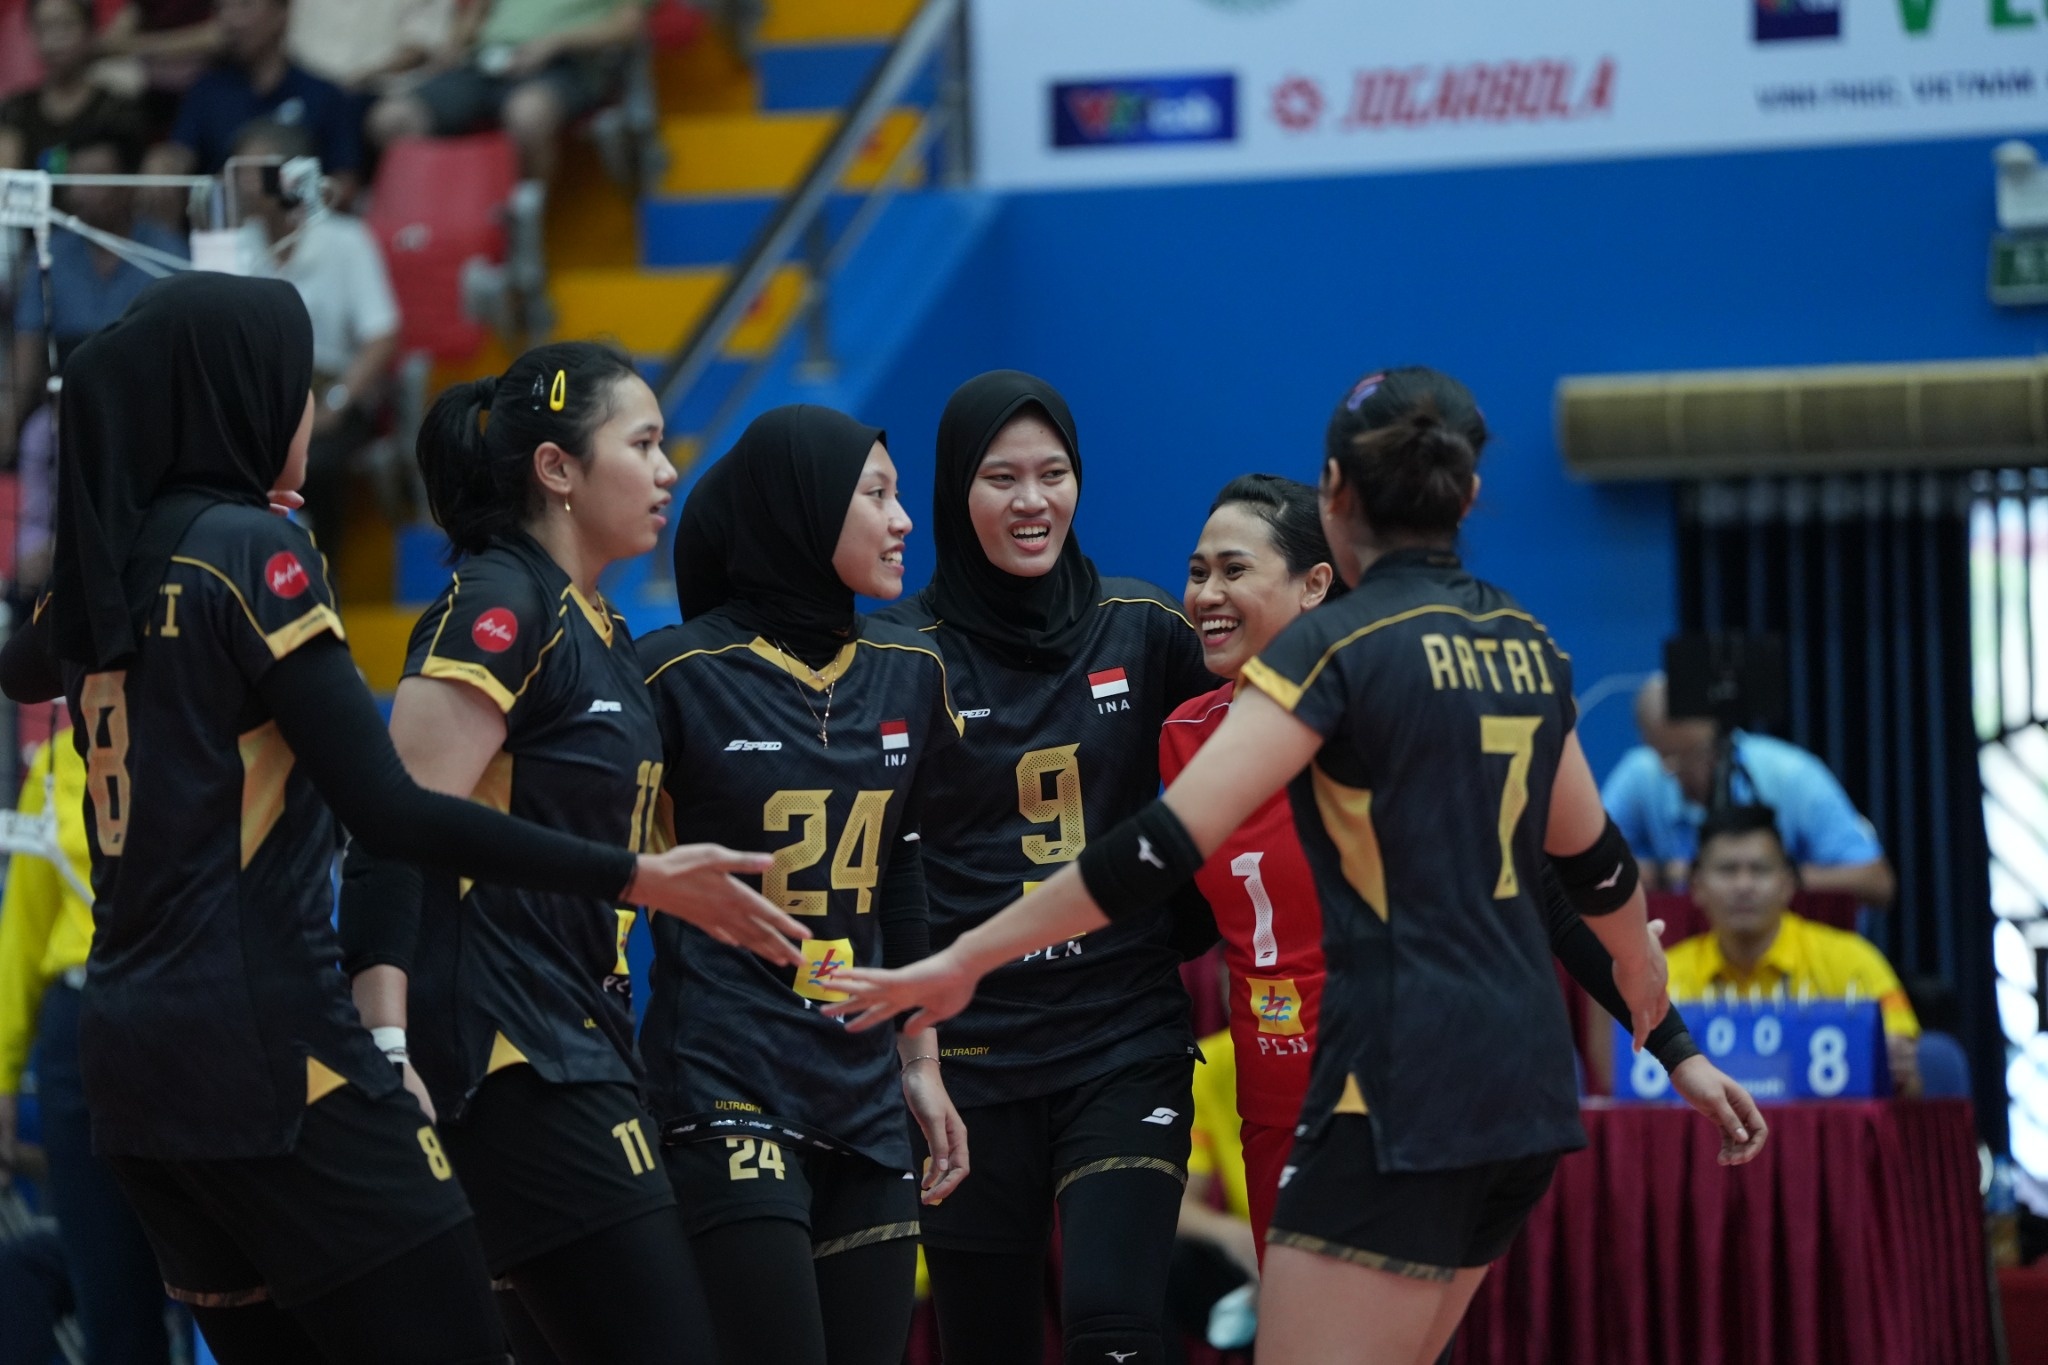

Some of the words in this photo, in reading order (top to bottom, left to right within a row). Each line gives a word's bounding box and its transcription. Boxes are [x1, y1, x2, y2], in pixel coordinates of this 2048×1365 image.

[1421, 633, 1554, 694] RATRI
[1098, 699, 1131, 715] INA
[80, 669, 131, 856] 8
[1016, 742, 1087, 865] 9
[1479, 715, 1544, 900] 7
[762, 789, 895, 917] 24
[1230, 852, 1278, 968] 1
[940, 1046, 990, 1057] ULTRADRY
[1257, 1036, 1308, 1055] PLN
[1706, 1016, 1736, 1057] 0
[1753, 1014, 1783, 1057] 0
[1808, 1026, 1850, 1098] 8
[715, 1100, 763, 1115] ULTRADRY
[416, 1125, 452, 1182] 8
[611, 1118, 656, 1176] 11
[725, 1137, 785, 1181] 24
